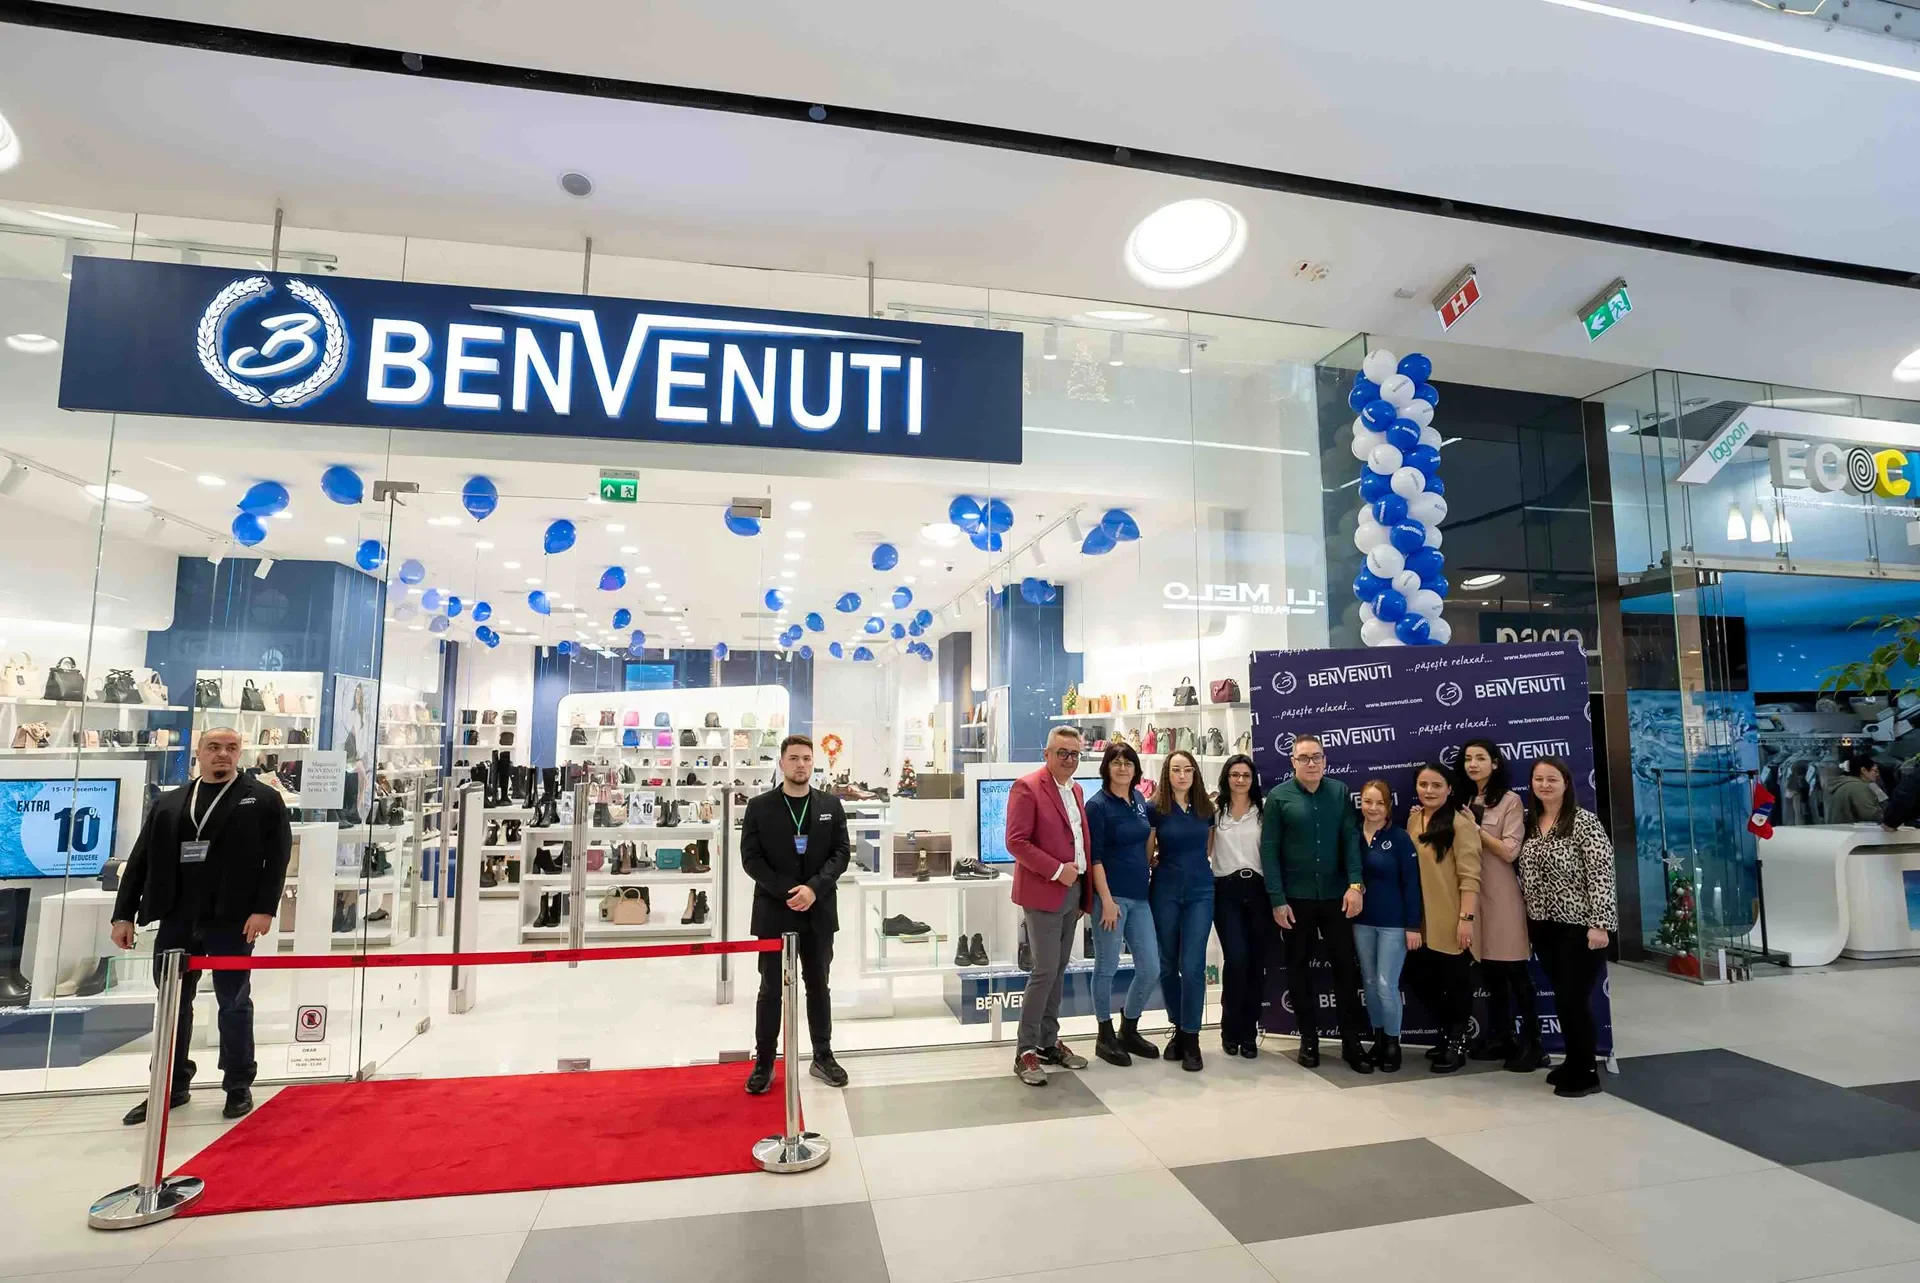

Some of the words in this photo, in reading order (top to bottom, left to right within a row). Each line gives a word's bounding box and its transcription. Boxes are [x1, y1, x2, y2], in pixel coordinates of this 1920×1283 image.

[366, 303, 923, 435] BENVENUTI
[1708, 420, 1749, 463] lagoon
[1503, 650, 1564, 661] www.benvenuti.com
[1308, 662, 1392, 687] BENVENUTI
[1475, 674, 1566, 698] BENVENUTI
[1365, 698, 1423, 709] www.benvenuti.com
[1508, 715, 1570, 725] www.benvenuti.com
[1496, 738, 1570, 761] NVENUTI
[1323, 763, 1358, 775] elaxat...
[17, 800, 50, 812] EXTRA
[642, 803, 652, 814] 10
